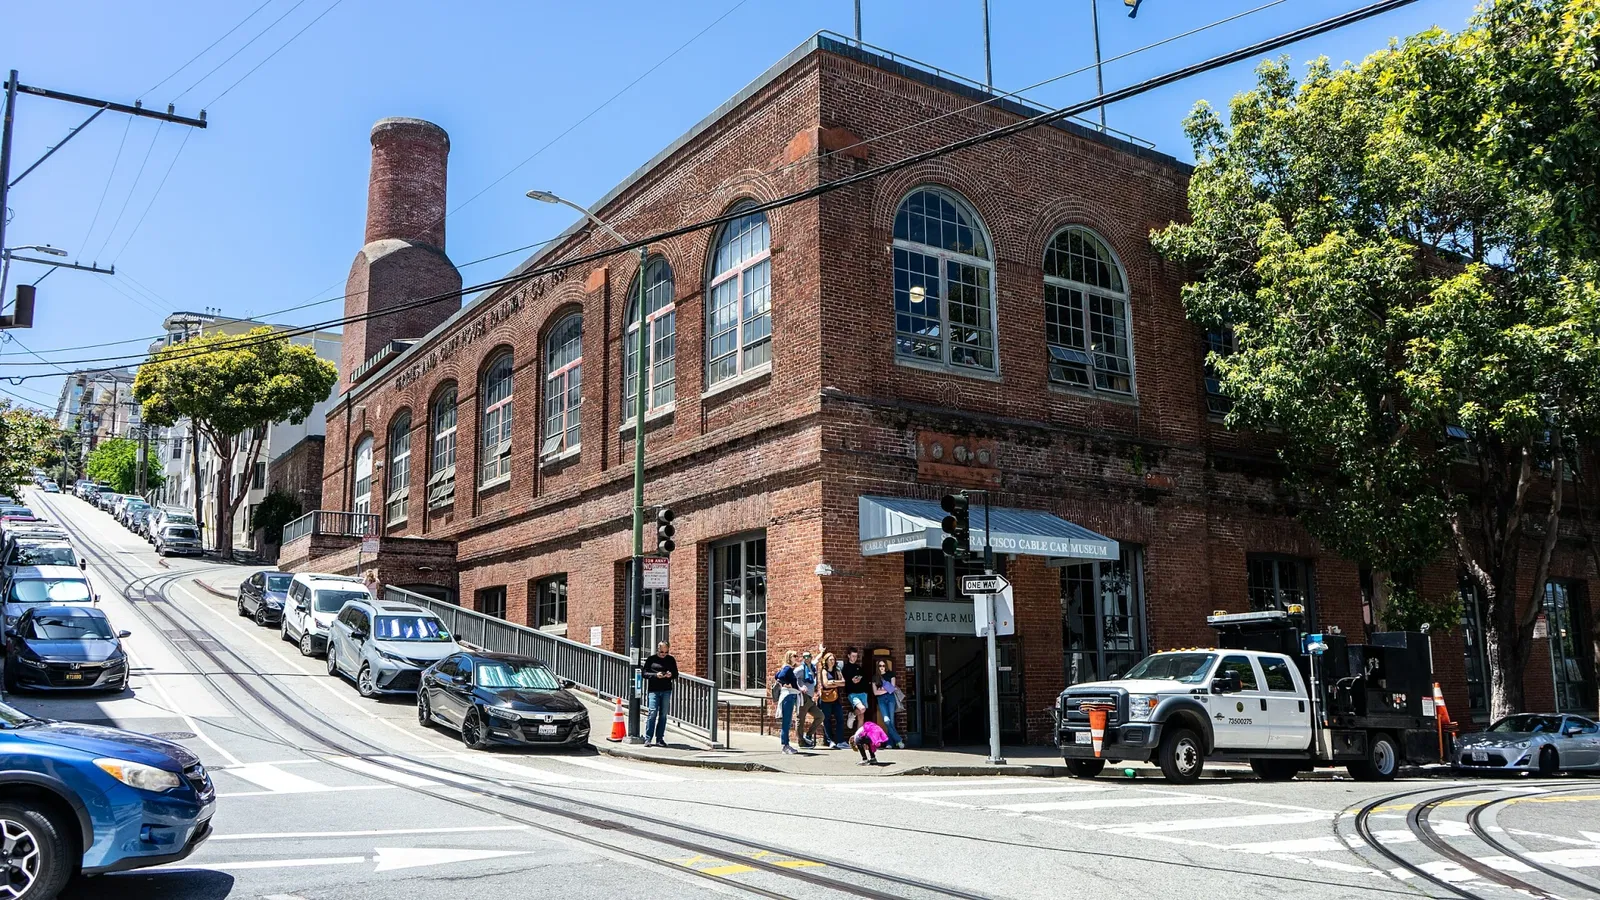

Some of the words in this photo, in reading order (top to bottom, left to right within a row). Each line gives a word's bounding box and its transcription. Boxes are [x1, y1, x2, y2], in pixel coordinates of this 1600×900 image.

[864, 539, 883, 552] CABLE
[883, 537, 895, 549] CAR
[969, 535, 1016, 549] RANCISCO
[1018, 538, 1048, 551] CABLE
[1049, 541, 1068, 552] CAR
[1070, 543, 1108, 556] MUSEUM
[967, 580, 981, 589] ONE
[982, 580, 996, 589] WAY
[904, 611, 933, 622] CABLE
[935, 612, 957, 623] CAR
[1228, 717, 1253, 725] 73500275
